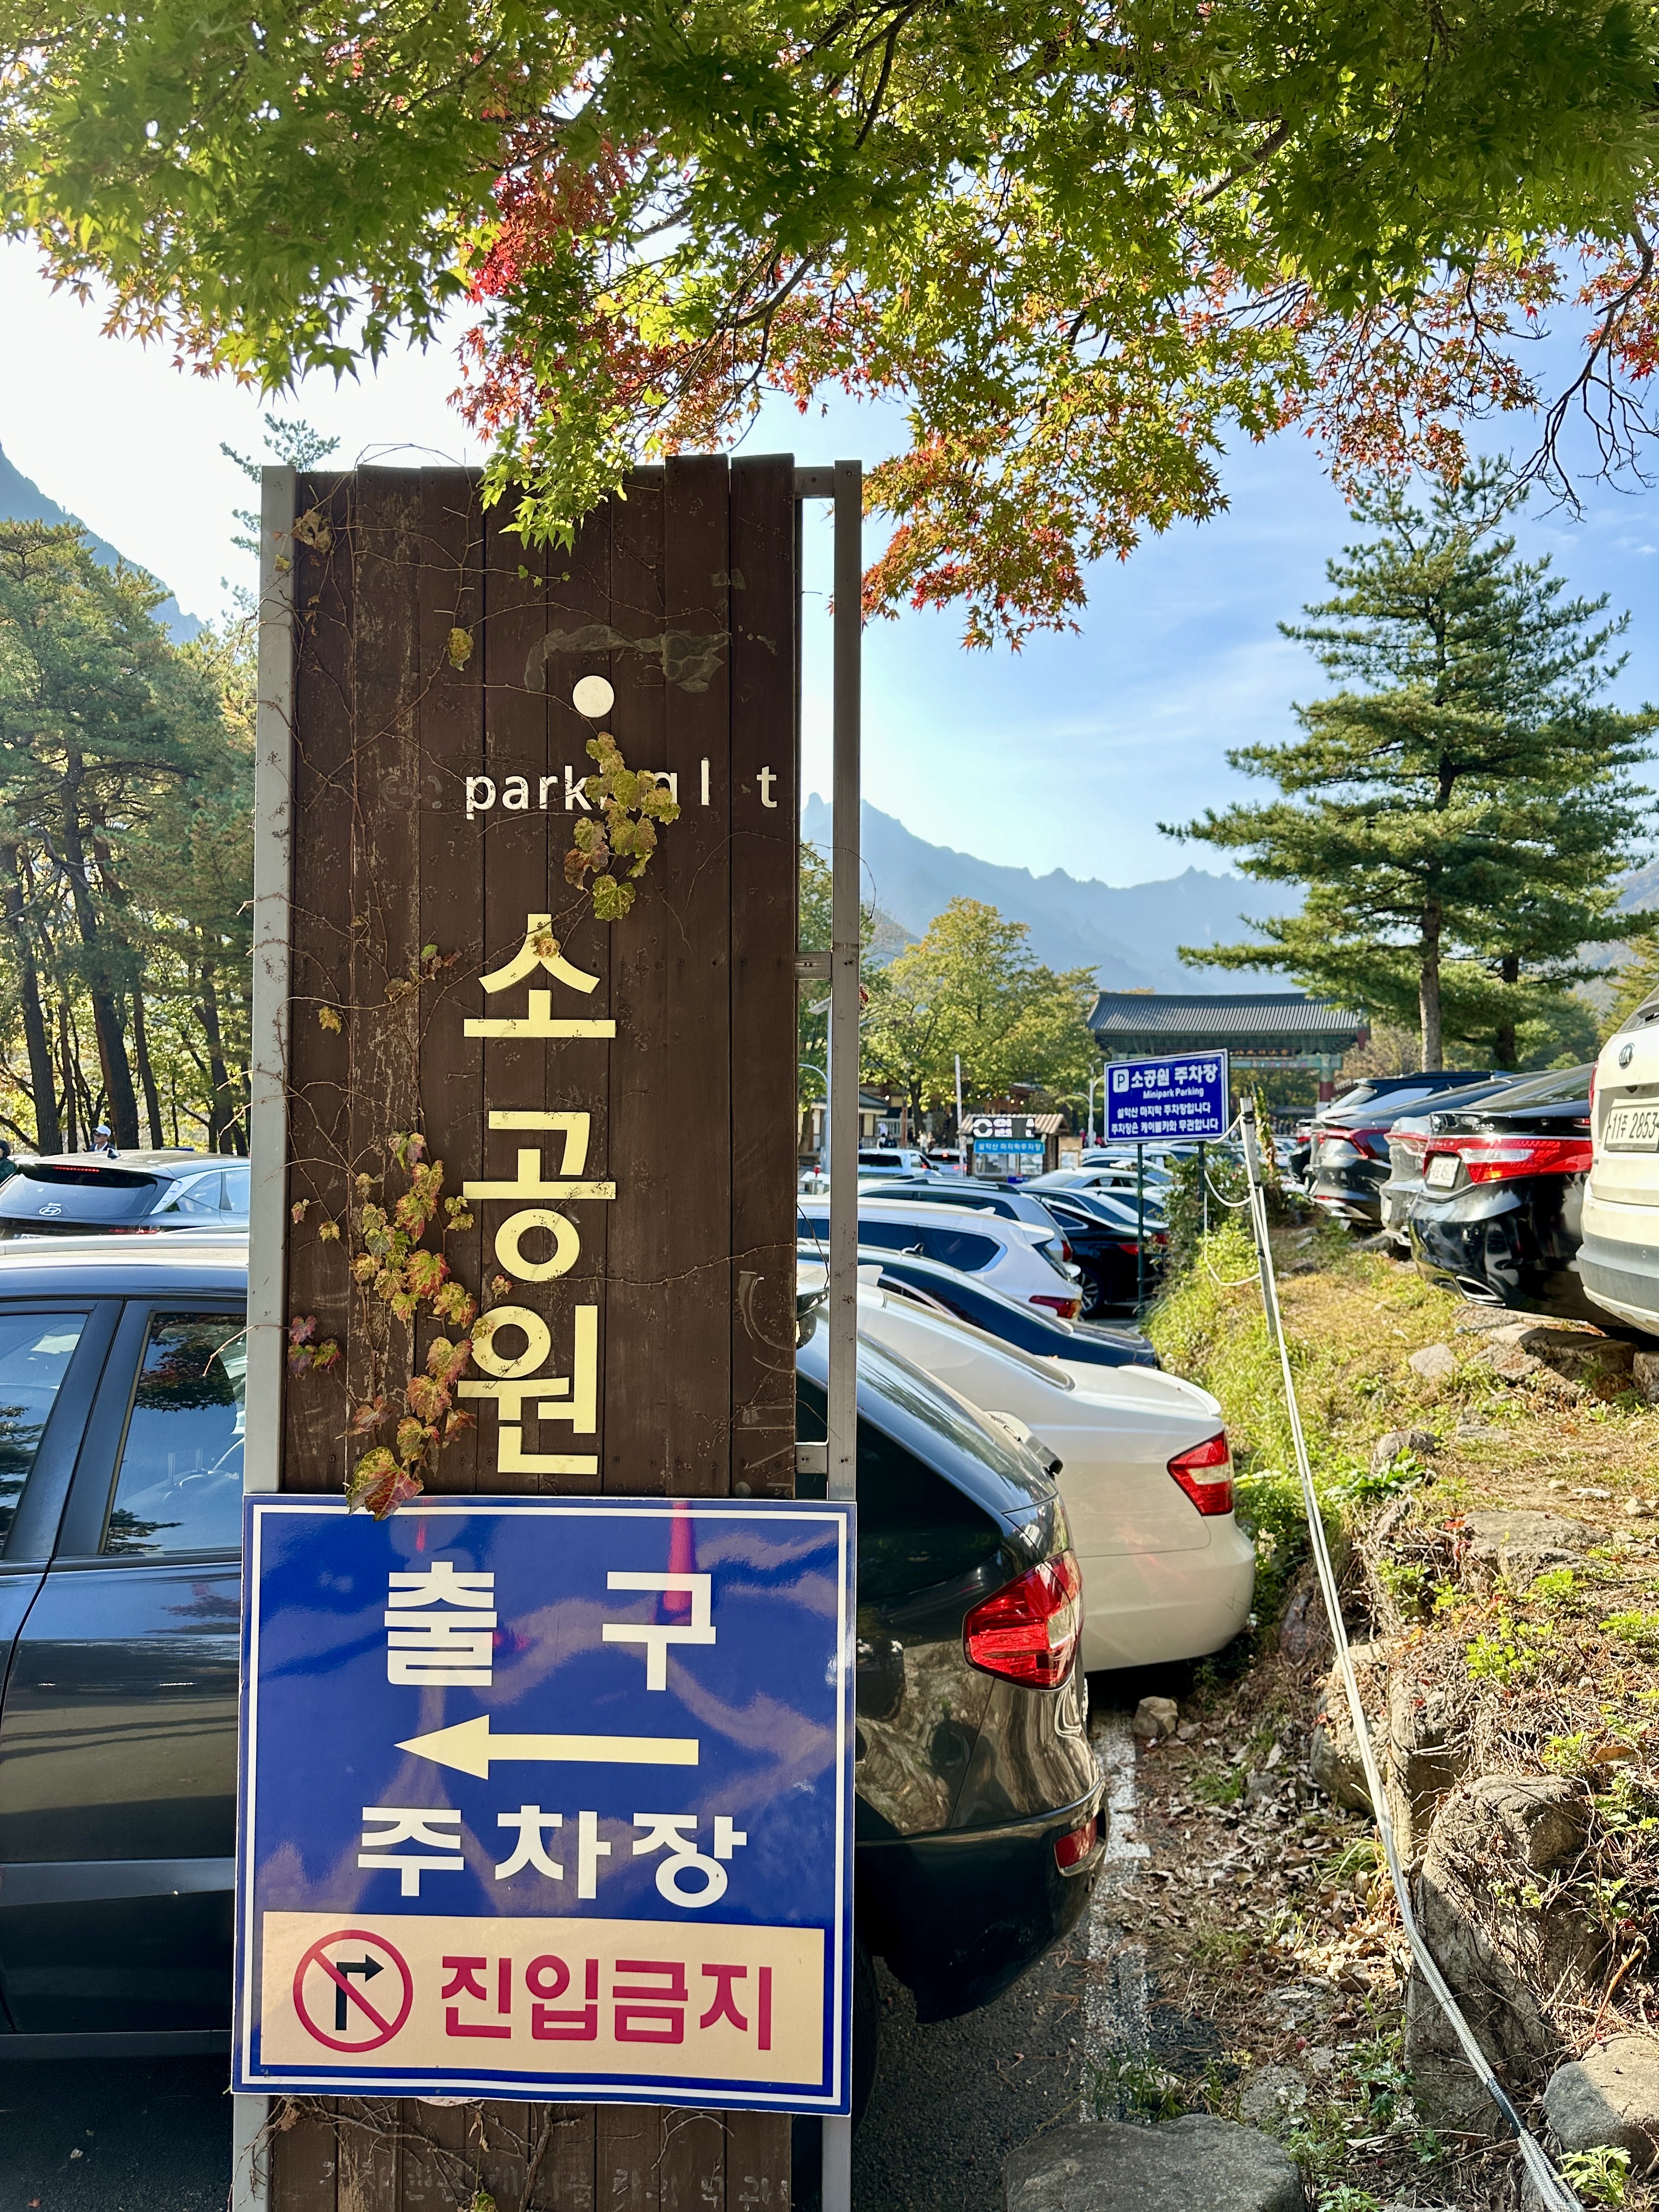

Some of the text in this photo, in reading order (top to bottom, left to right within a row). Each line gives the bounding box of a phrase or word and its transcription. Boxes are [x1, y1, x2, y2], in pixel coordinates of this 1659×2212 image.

[1118, 1074, 1125, 1088] P
[1131, 1063, 1218, 1089] 소공원 주차장
[1143, 1086, 1204, 1100] Minipark Parking
[1117, 1102, 1211, 1119] 설악산 마지막 주차장입니다
[1111, 1118, 1219, 1135] 주차장은 케이블카와 무관합니다
[1611, 1111, 1658, 1139] 11주 2853
[456, 913, 617, 1475] 소공원
[357, 1805, 748, 1908] 주차장
[441, 1954, 772, 2051] 진입금지
